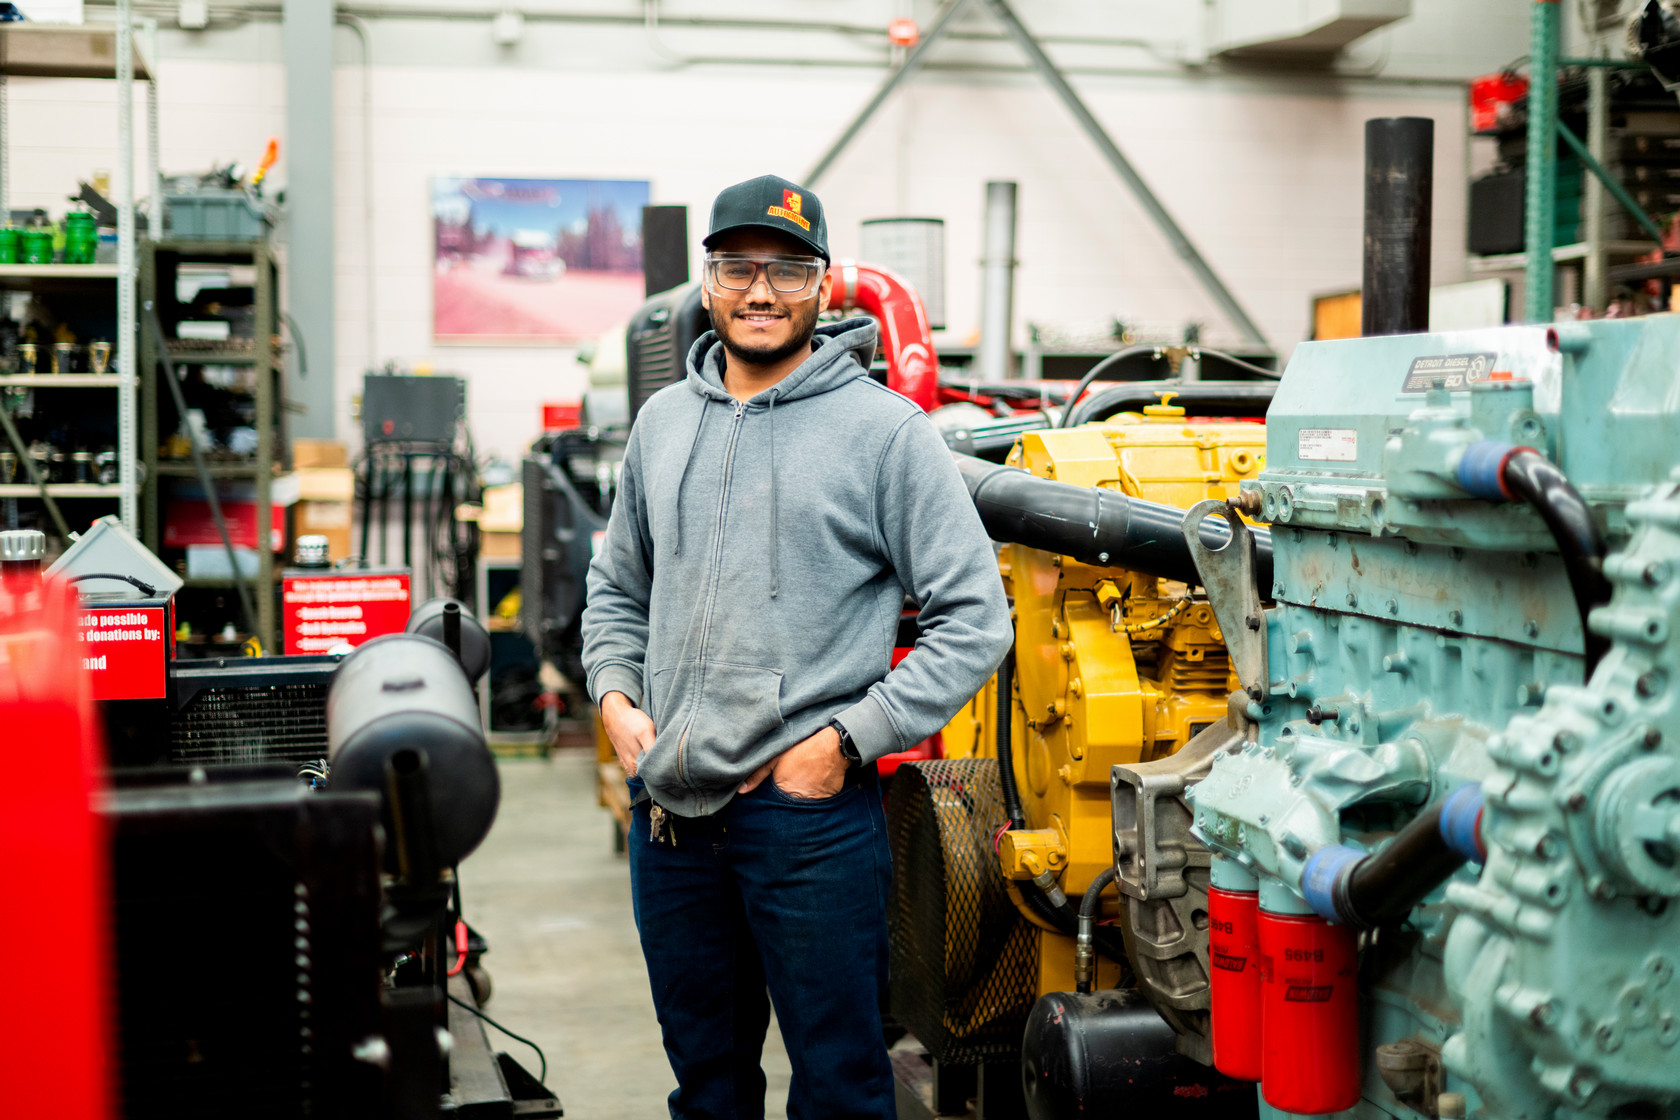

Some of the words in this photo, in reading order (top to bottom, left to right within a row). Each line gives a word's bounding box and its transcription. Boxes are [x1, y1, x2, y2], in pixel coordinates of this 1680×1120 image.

[1414, 359, 1444, 369] DETROIT
[1445, 357, 1469, 367] DIESEL
[78, 614, 98, 626] ade
[100, 612, 148, 627] possible
[86, 628, 142, 642] donations
[144, 627, 160, 641] by:
[82, 655, 107, 670] and
[1284, 948, 1324, 963] B495
